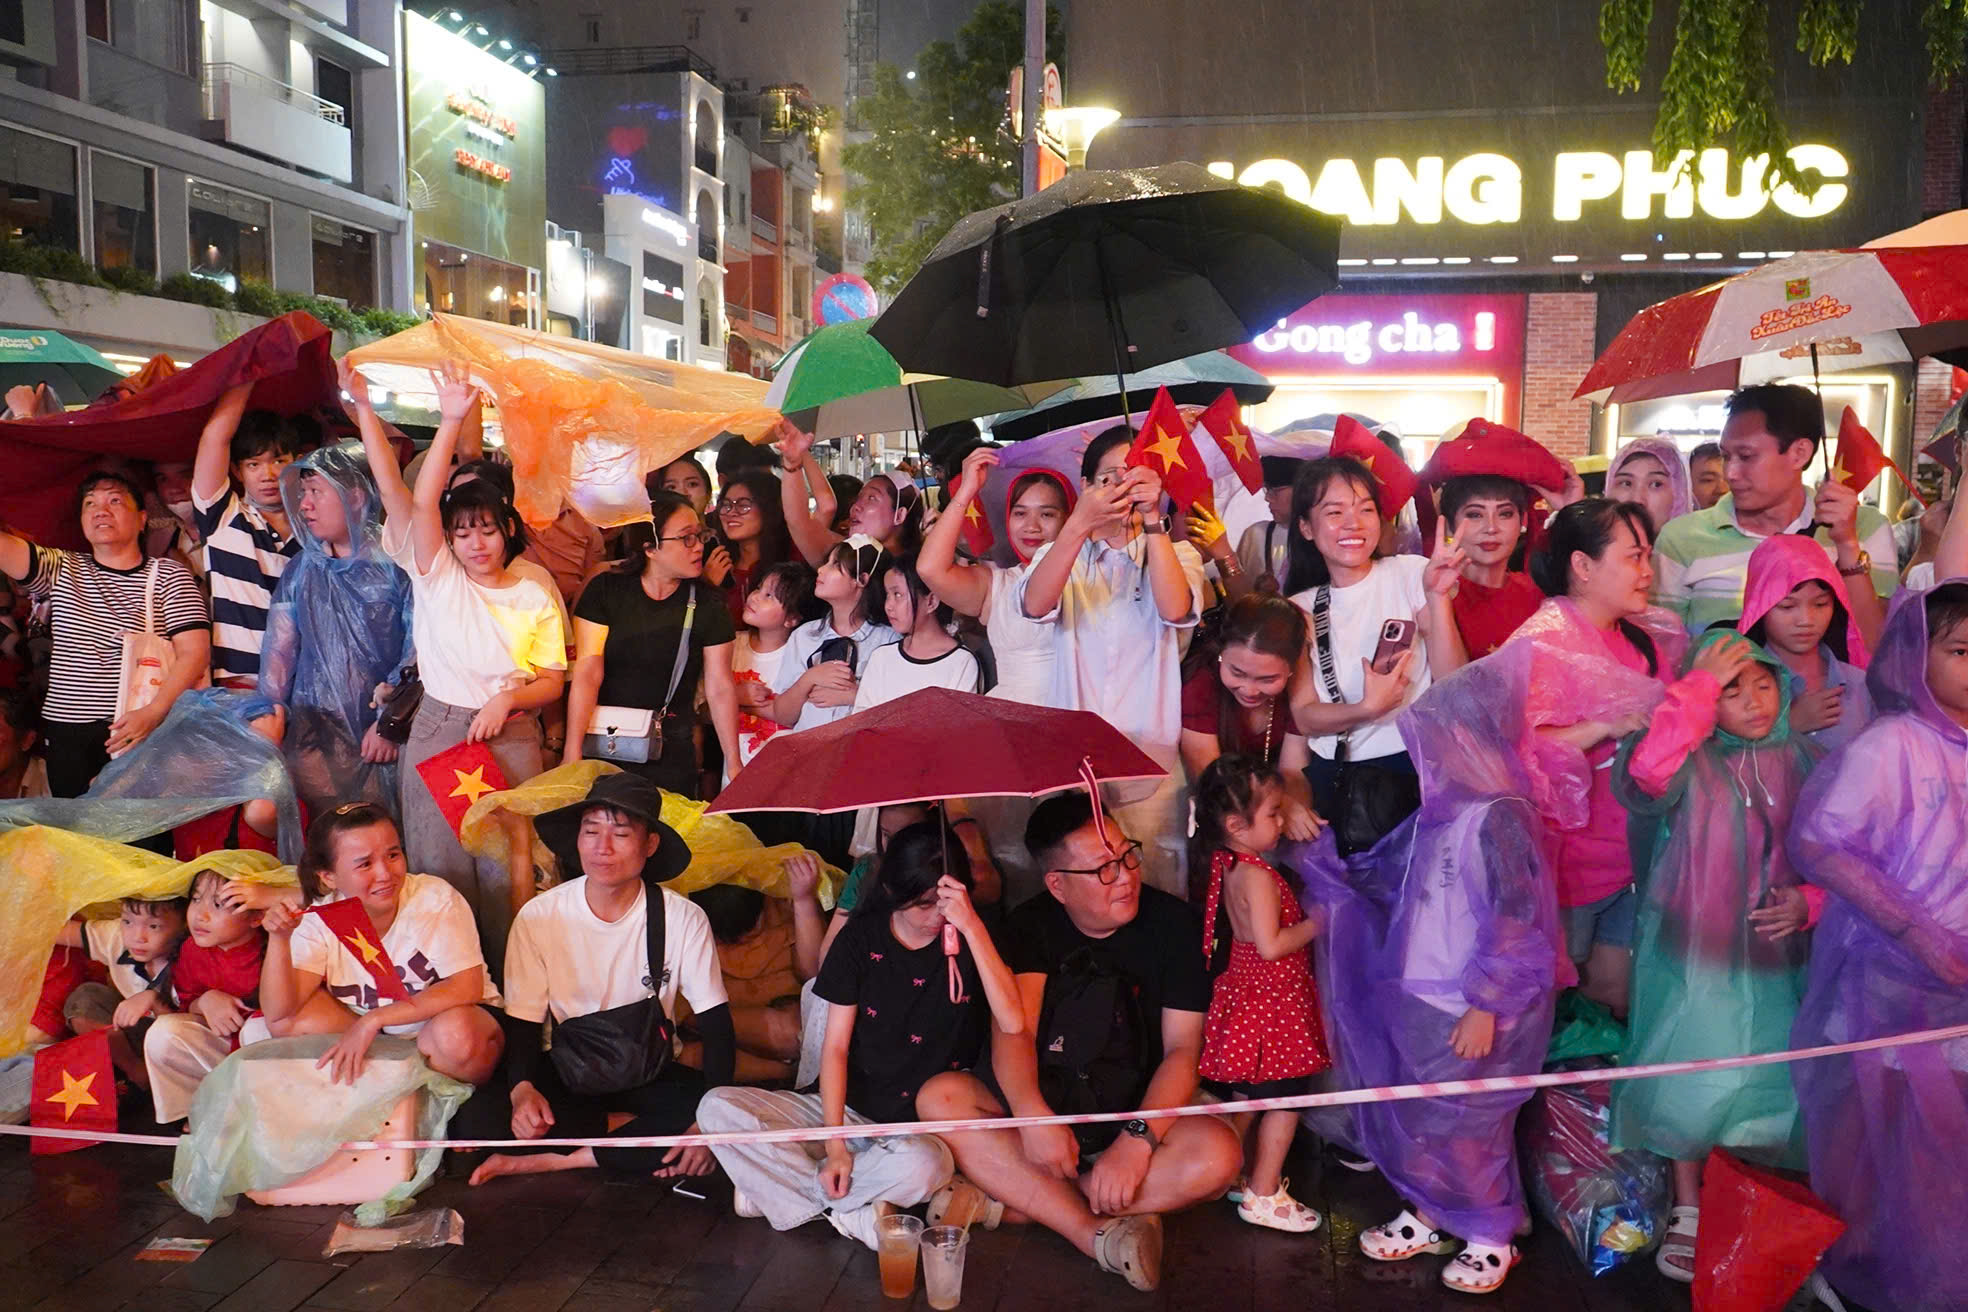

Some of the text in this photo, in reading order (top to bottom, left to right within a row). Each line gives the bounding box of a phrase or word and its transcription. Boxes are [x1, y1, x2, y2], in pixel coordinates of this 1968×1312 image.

[1207, 152, 1522, 225] OANG
[1253, 317, 1373, 365] Gong
[1378, 311, 1462, 352] cha
